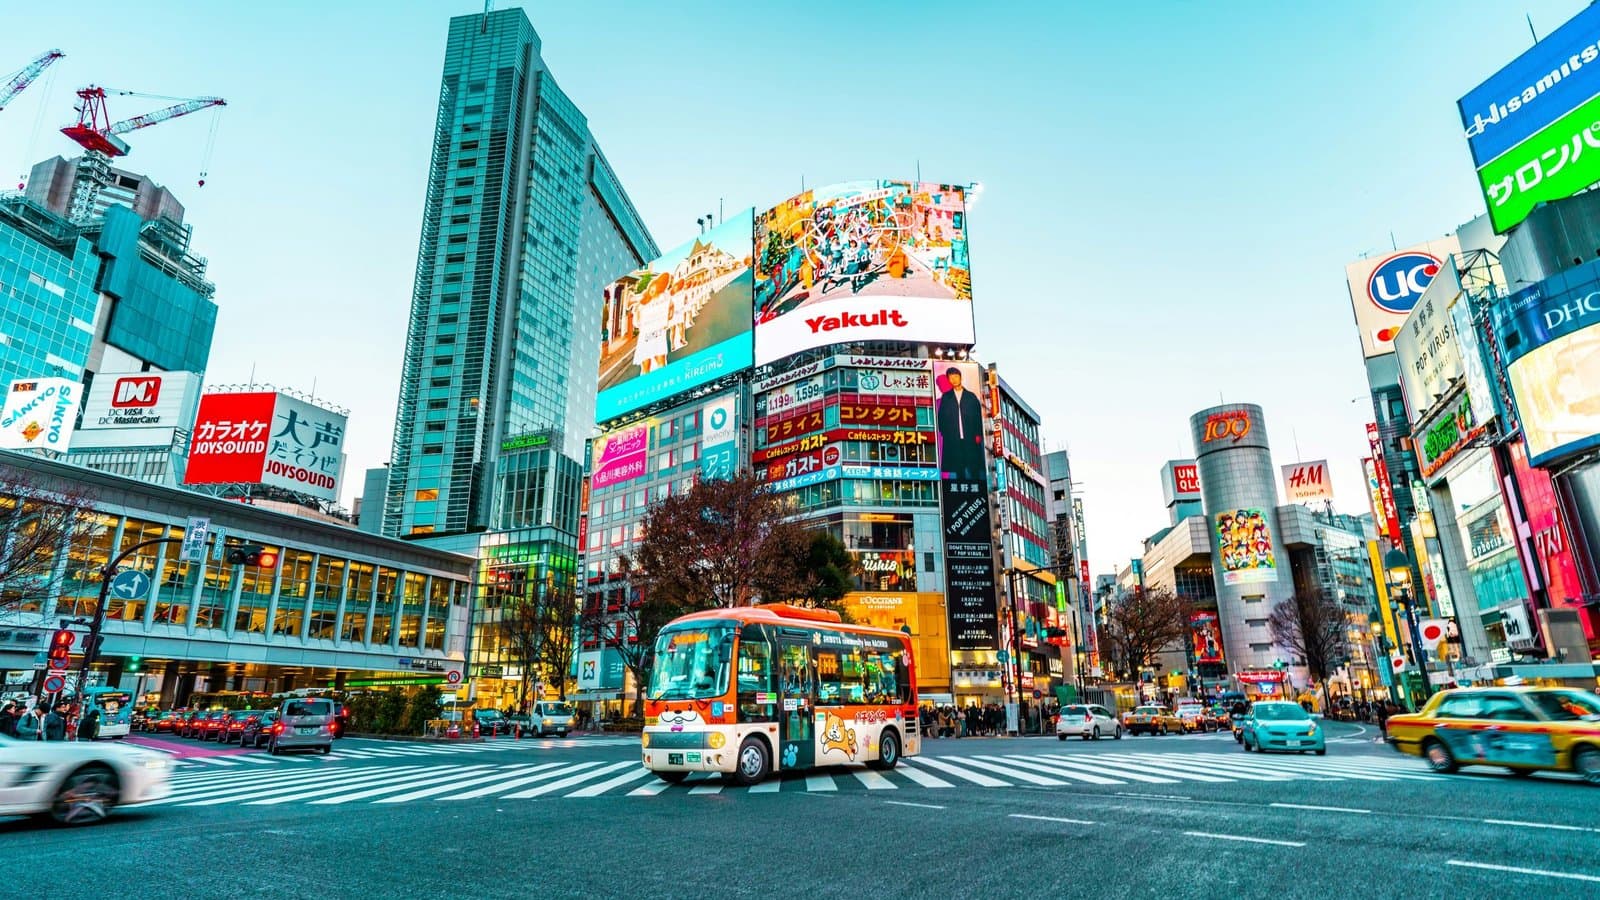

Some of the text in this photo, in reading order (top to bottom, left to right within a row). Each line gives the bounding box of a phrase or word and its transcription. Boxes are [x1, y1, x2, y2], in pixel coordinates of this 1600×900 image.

[1465, 40, 1600, 138] Hisamits
[1509, 290, 1540, 313] Channel
[805, 309, 908, 334] Yakult
[850, 356, 928, 368] しゃぶしゃぶバイキング
[116, 381, 156, 402] DC
[883, 374, 929, 389] しゃぶ葉
[1, 387, 56, 428] SANKYO
[47, 385, 71, 443] SANKYO
[756, 400, 767, 411] 9F
[840, 405, 914, 422] コンタクト
[113, 416, 160, 424] MasterCard
[197, 420, 267, 440] カラオケ
[272, 409, 342, 449] 大声
[1203, 418, 1251, 443] 109
[193, 441, 265, 454] JOYSOUND
[800, 434, 828, 452] ガスト
[893, 430, 928, 445] ガスト
[265, 460, 335, 489] JOYSOUND
[756, 469, 767, 481] 7F
[786, 455, 819, 477] ガスト
[1289, 464, 1322, 488] H&M
